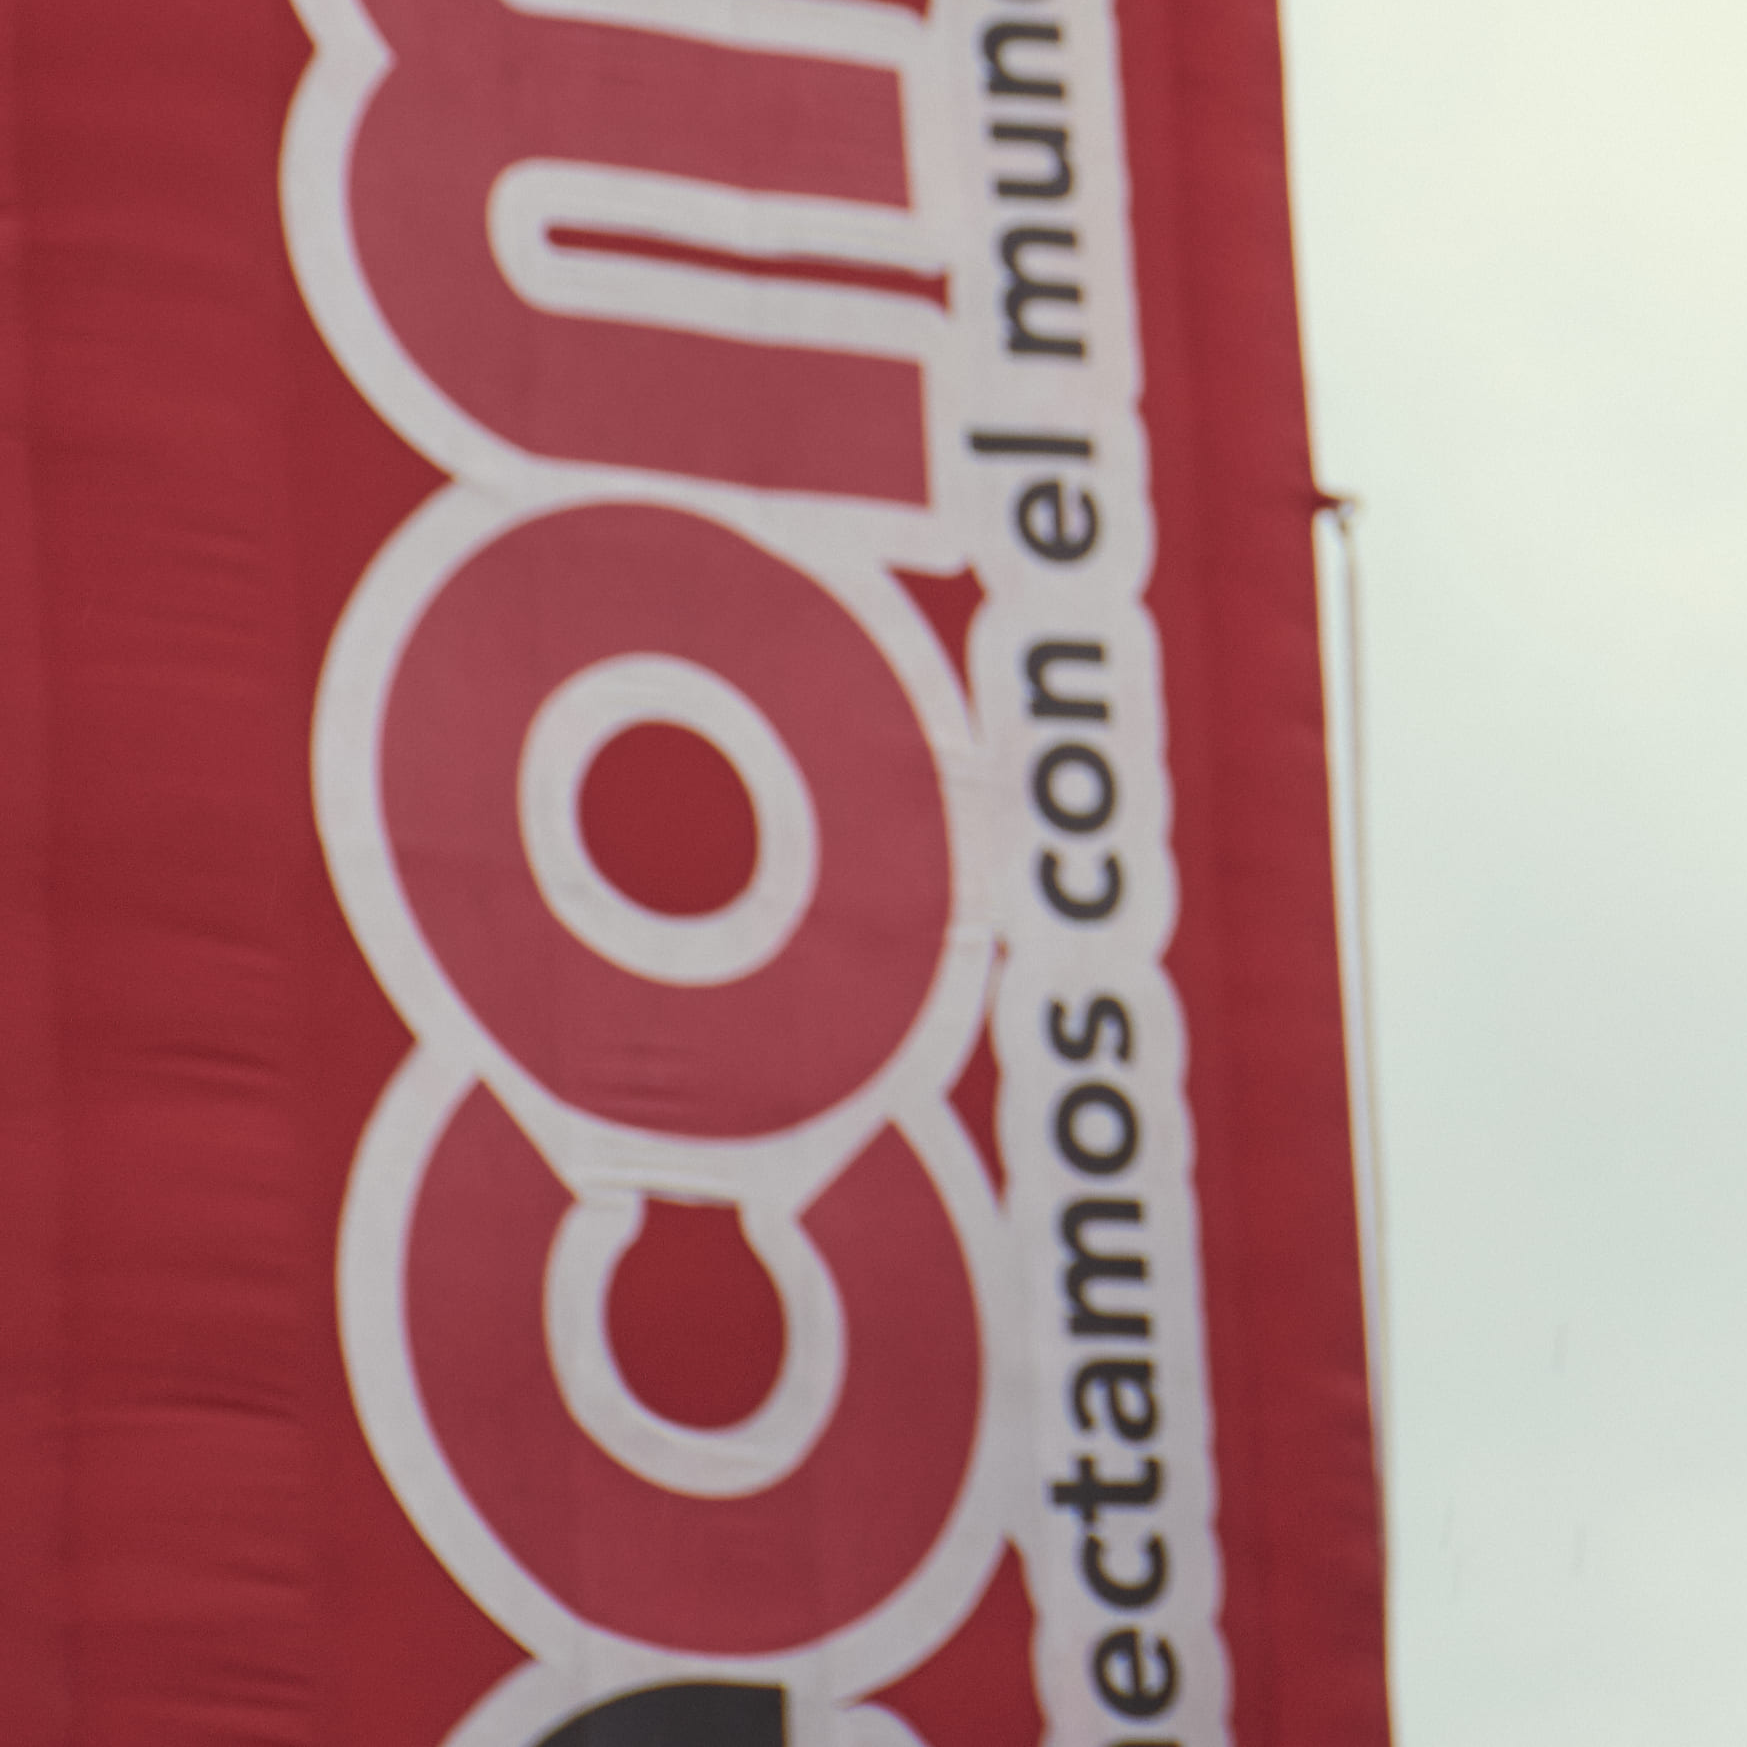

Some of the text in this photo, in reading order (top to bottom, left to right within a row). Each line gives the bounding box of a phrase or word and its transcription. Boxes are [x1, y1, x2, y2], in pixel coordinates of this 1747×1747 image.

[967, 429, 1101, 565] el
[1027, 637, 1124, 924] con
[1046, 994, 1186, 1747] ectamos
